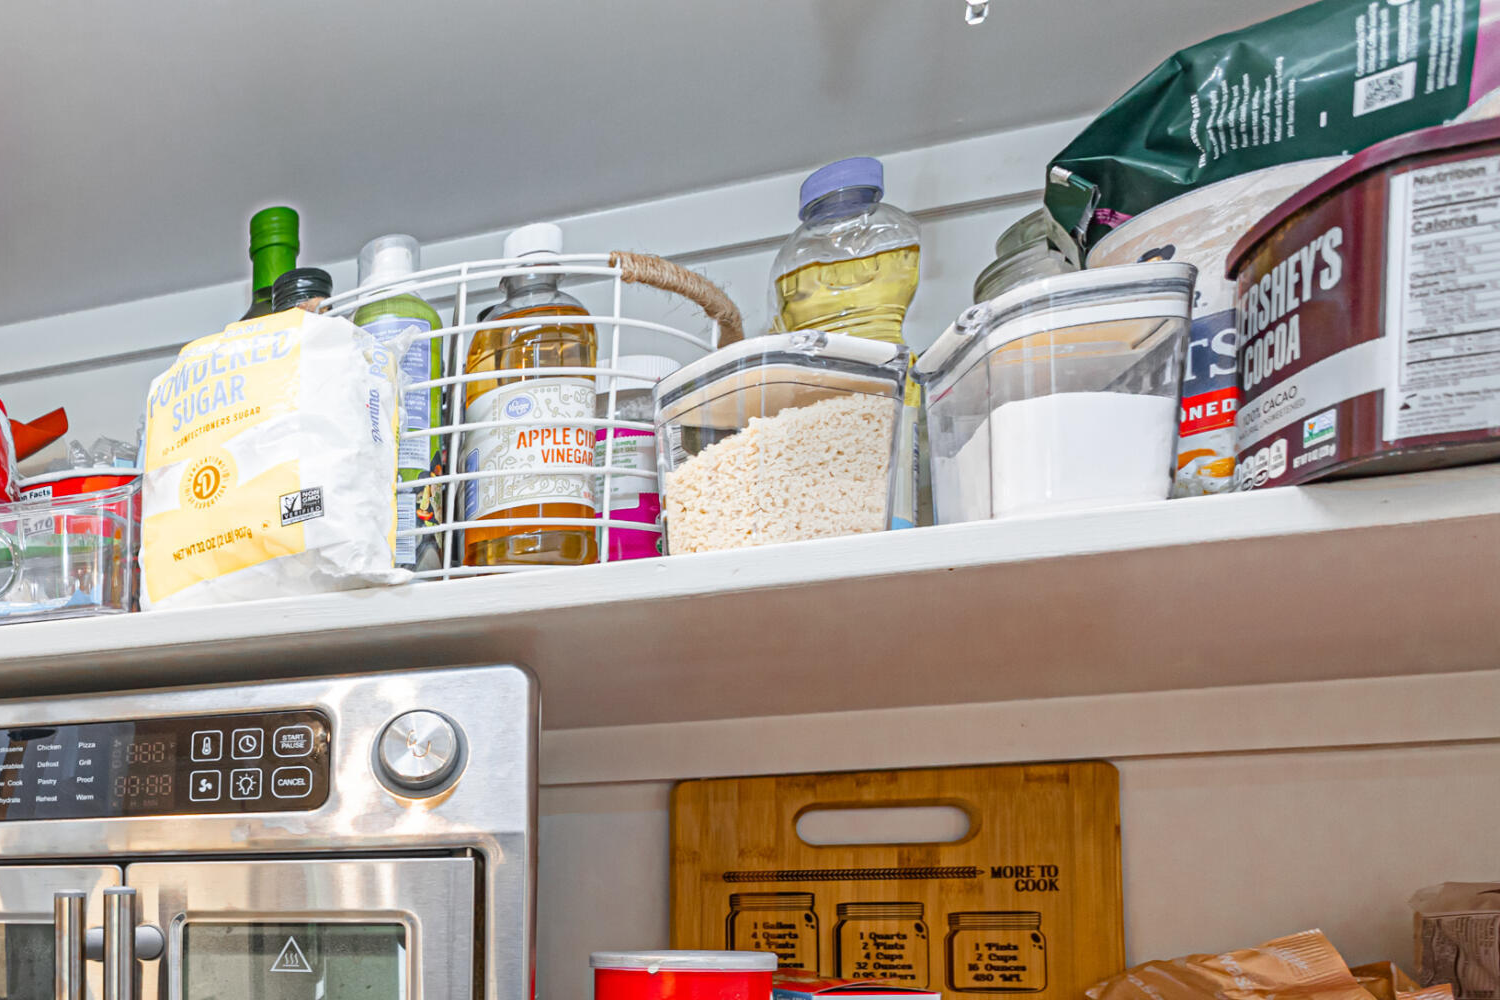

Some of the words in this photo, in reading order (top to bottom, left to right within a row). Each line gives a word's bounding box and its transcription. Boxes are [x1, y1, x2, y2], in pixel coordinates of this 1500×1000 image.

[1190, 95, 1202, 118] ROAST
[1413, 167, 1486, 184] Nutrition
[1412, 215, 1478, 233] Calories
[1240, 226, 1343, 342] ERSHEY'S
[1244, 314, 1300, 391] COCOA
[172, 375, 246, 433] SUGAR
[1262, 385, 1298, 414] CACAO
[366, 389, 383, 444] Domino
[177, 415, 231, 450] CONFECTIONERS
[233, 406, 261, 422] SUGAR
[516, 427, 571, 449] APPLE
[541, 448, 594, 466] VINEGAR
[29, 488, 51, 500] Facts
[301, 489, 320, 498] NON
[282, 505, 322, 520] VERIFIED
[172, 548, 185, 560] NET
[186, 545, 197, 556] WT
[206, 539, 216, 550] OZ
[281, 733, 304, 741] START
[280, 741, 305, 749] PAUSE
[37, 760, 59, 768] Defrost
[78, 758, 92, 766] Grill
[37, 778, 58, 786] Pastry
[76, 776, 94, 784] Proof
[277, 778, 306, 787] CANCEL
[76, 793, 94, 801] Warm
[990, 866, 1035, 879] MORE
[1040, 865, 1058, 878] TO
[1014, 879, 1060, 892] COOK
[762, 931, 799, 941] Quarts
[868, 931, 908, 941] Quarts
[874, 941, 905, 951] Pints
[984, 942, 1019, 951] Pints
[875, 952, 904, 961] Cups
[987, 953, 1018, 962] Cups
[855, 962, 869, 970] 32
[873, 962, 913, 970] Ounces
[968, 963, 979, 972] 16
[984, 963, 1027, 972] Ounces
[972, 974, 994, 982] 480
